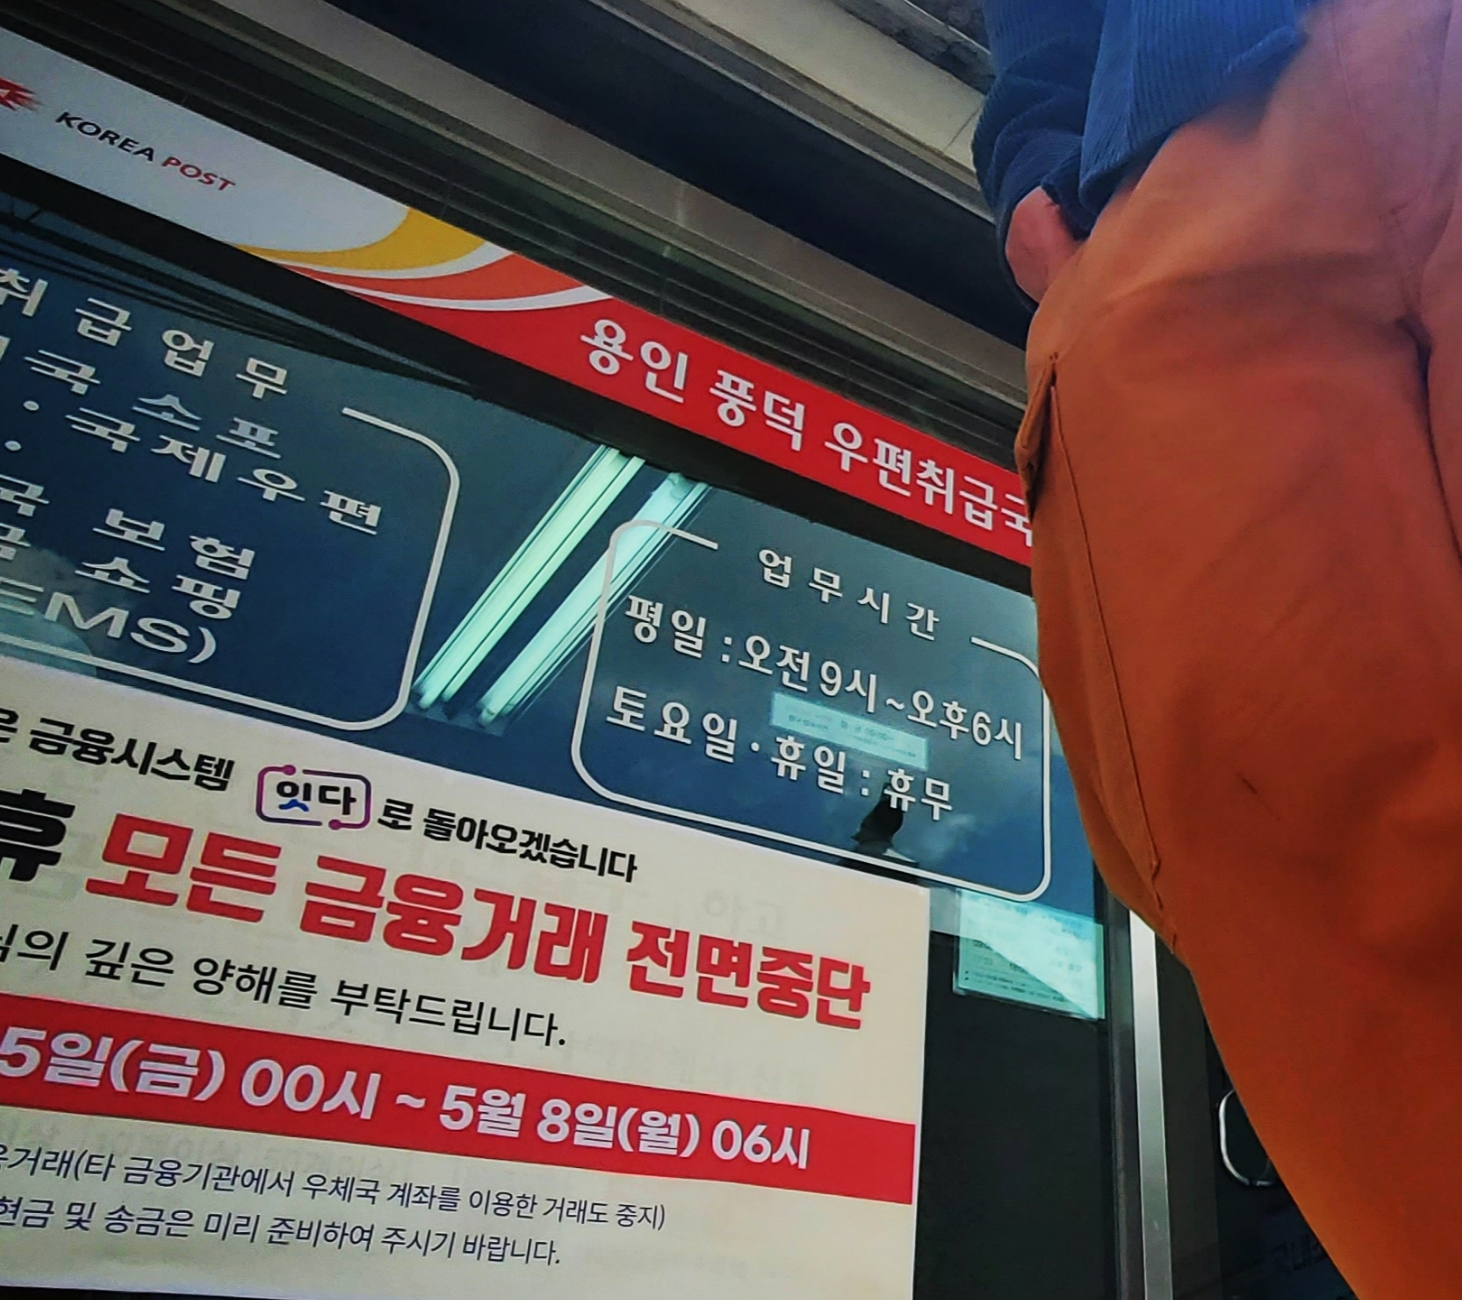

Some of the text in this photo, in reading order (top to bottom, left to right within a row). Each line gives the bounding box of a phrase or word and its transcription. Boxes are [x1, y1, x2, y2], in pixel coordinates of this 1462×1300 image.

[56, 112, 235, 191] KOREA POST
[580, 318, 1033, 547] 용인 풍덕 우편취급국
[29, 716, 235, 791] 금융시스템
[377, 798, 413, 832] 로
[423, 800, 638, 883] 돌아오겠습니다
[85, 813, 282, 923] 모든
[299, 855, 608, 985] 금융거래
[626, 920, 871, 1030] 전면중단
[85, 938, 175, 988] 깊은
[193, 956, 318, 1011] 양해를
[330, 981, 567, 1048] 부탁드립니다.
[0, 1025, 225, 1101] 5일(금)
[240, 1058, 381, 1121] 00시
[439, 1085, 526, 1139] 5월
[536, 1098, 700, 1159] 8일(월)
[711, 1120, 811, 1170] 06시
[64, 1202, 97, 1232] 및
[104, 1205, 195, 1238] 송금은
[203, 1212, 260, 1243] 미리
[266, 1216, 375, 1252] 준비하여
[380, 1226, 457, 1259] 주시기
[462, 1233, 561, 1266] 바랍니다.
[123, 1156, 295, 1198] 금융기관에서
[301, 1174, 381, 1204] 우체국
[386, 1182, 461, 1213] 계좌를
[469, 1189, 538, 1219] 이용한
[543, 1196, 610, 1225] 거래도
[615, 1203, 666, 1231] 중지)
